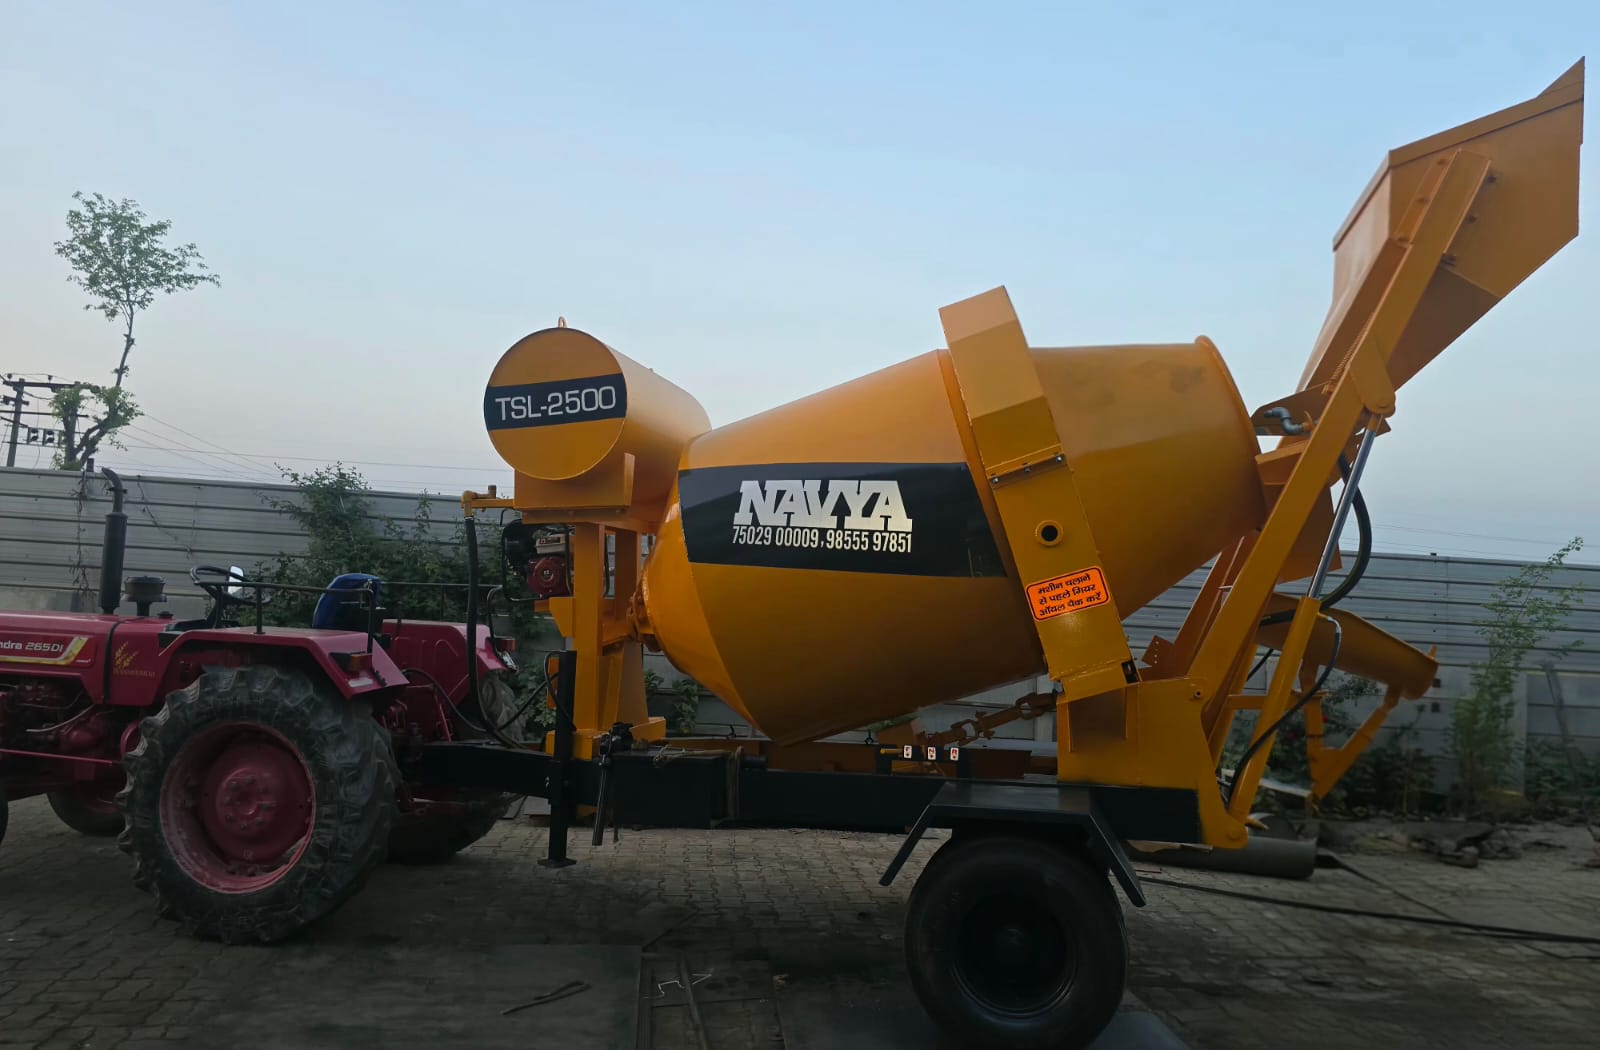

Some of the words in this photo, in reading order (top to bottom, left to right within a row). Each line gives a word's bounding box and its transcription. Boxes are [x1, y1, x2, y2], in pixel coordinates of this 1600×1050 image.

[495, 385, 616, 421] TSL-2500
[733, 479, 913, 532] NAVYA
[732, 526, 772, 546] 75029
[826, 529, 869, 551] 98555
[872, 531, 912, 553] 97851
